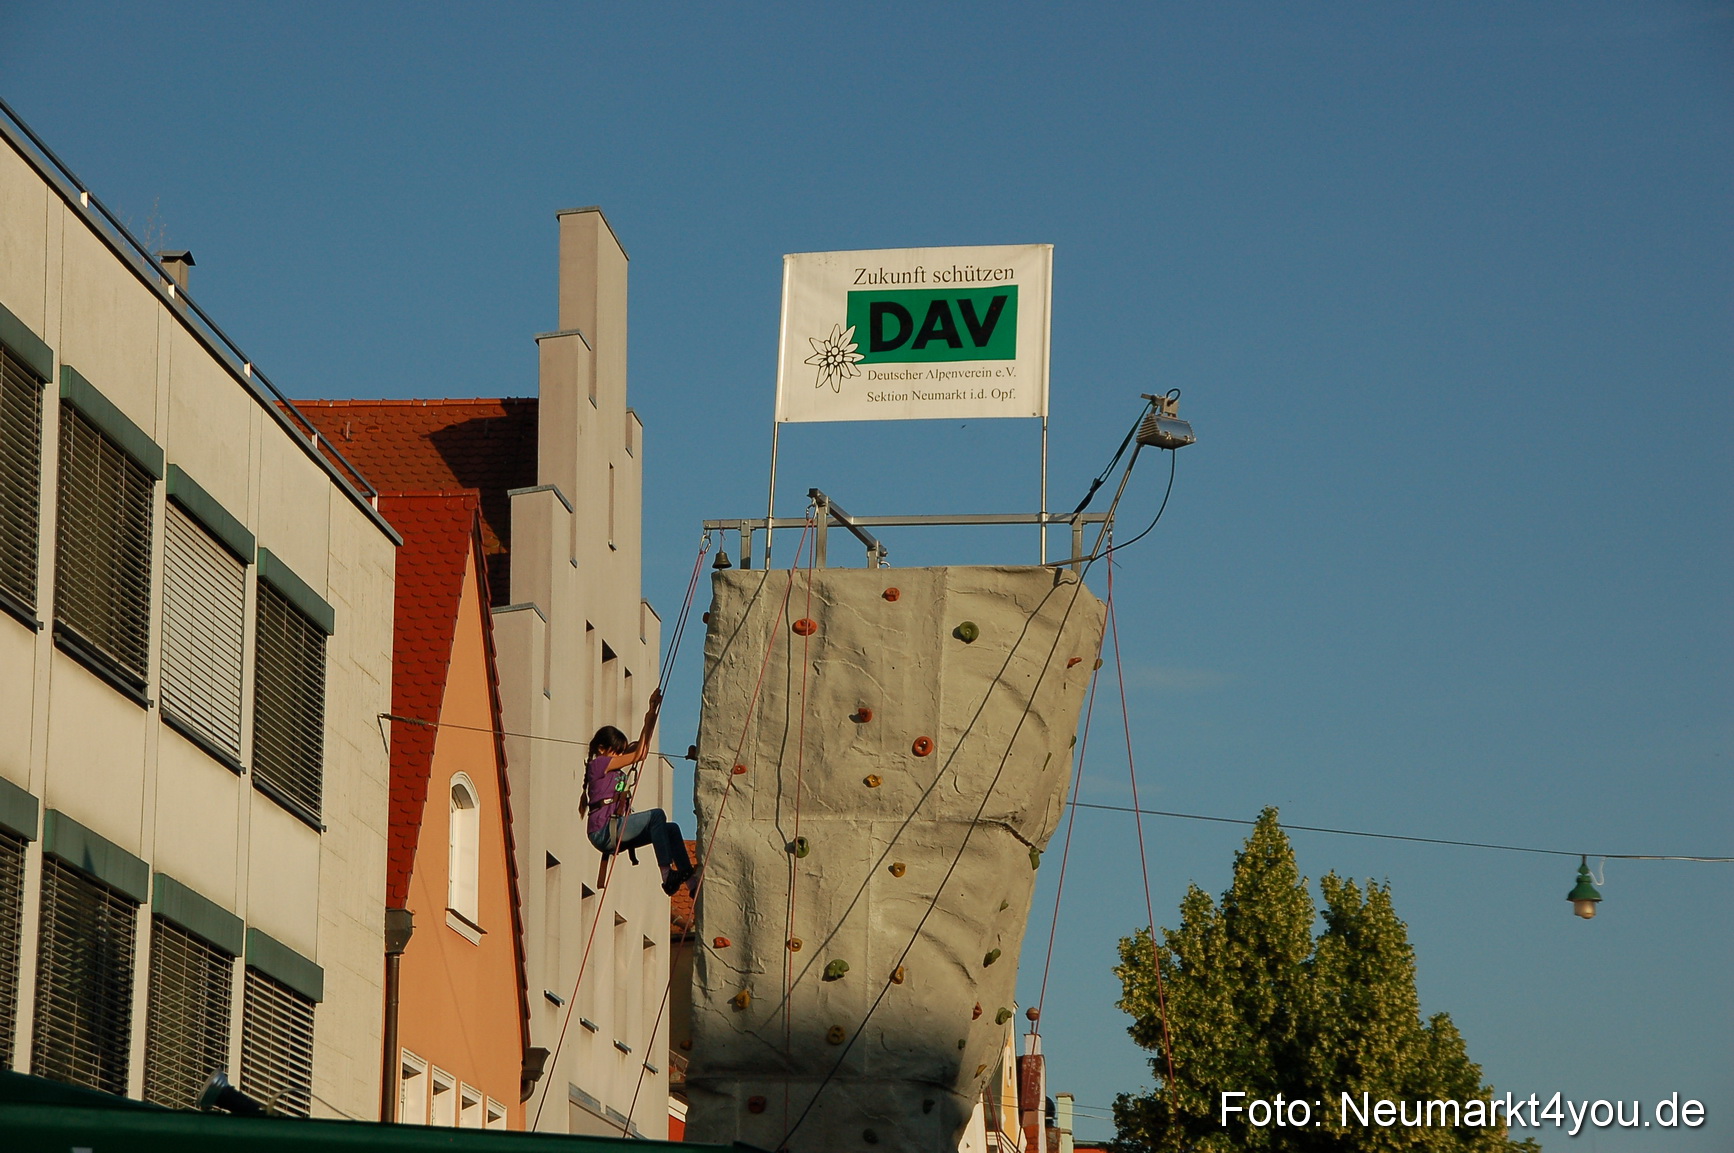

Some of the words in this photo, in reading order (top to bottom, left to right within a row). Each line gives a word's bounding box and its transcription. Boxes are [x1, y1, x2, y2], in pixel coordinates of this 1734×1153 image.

[853, 266, 927, 286] Zukunft
[932, 264, 1015, 283] schützen
[869, 295, 1009, 353] DAV
[867, 368, 923, 381] Deutscher
[925, 367, 992, 382] Alpenverein
[995, 366, 1017, 378] e.V.
[866, 390, 908, 403] Sektion
[911, 388, 967, 401] Neumarkt
[970, 388, 987, 400] i.d.
[991, 387, 1016, 402] Opf.
